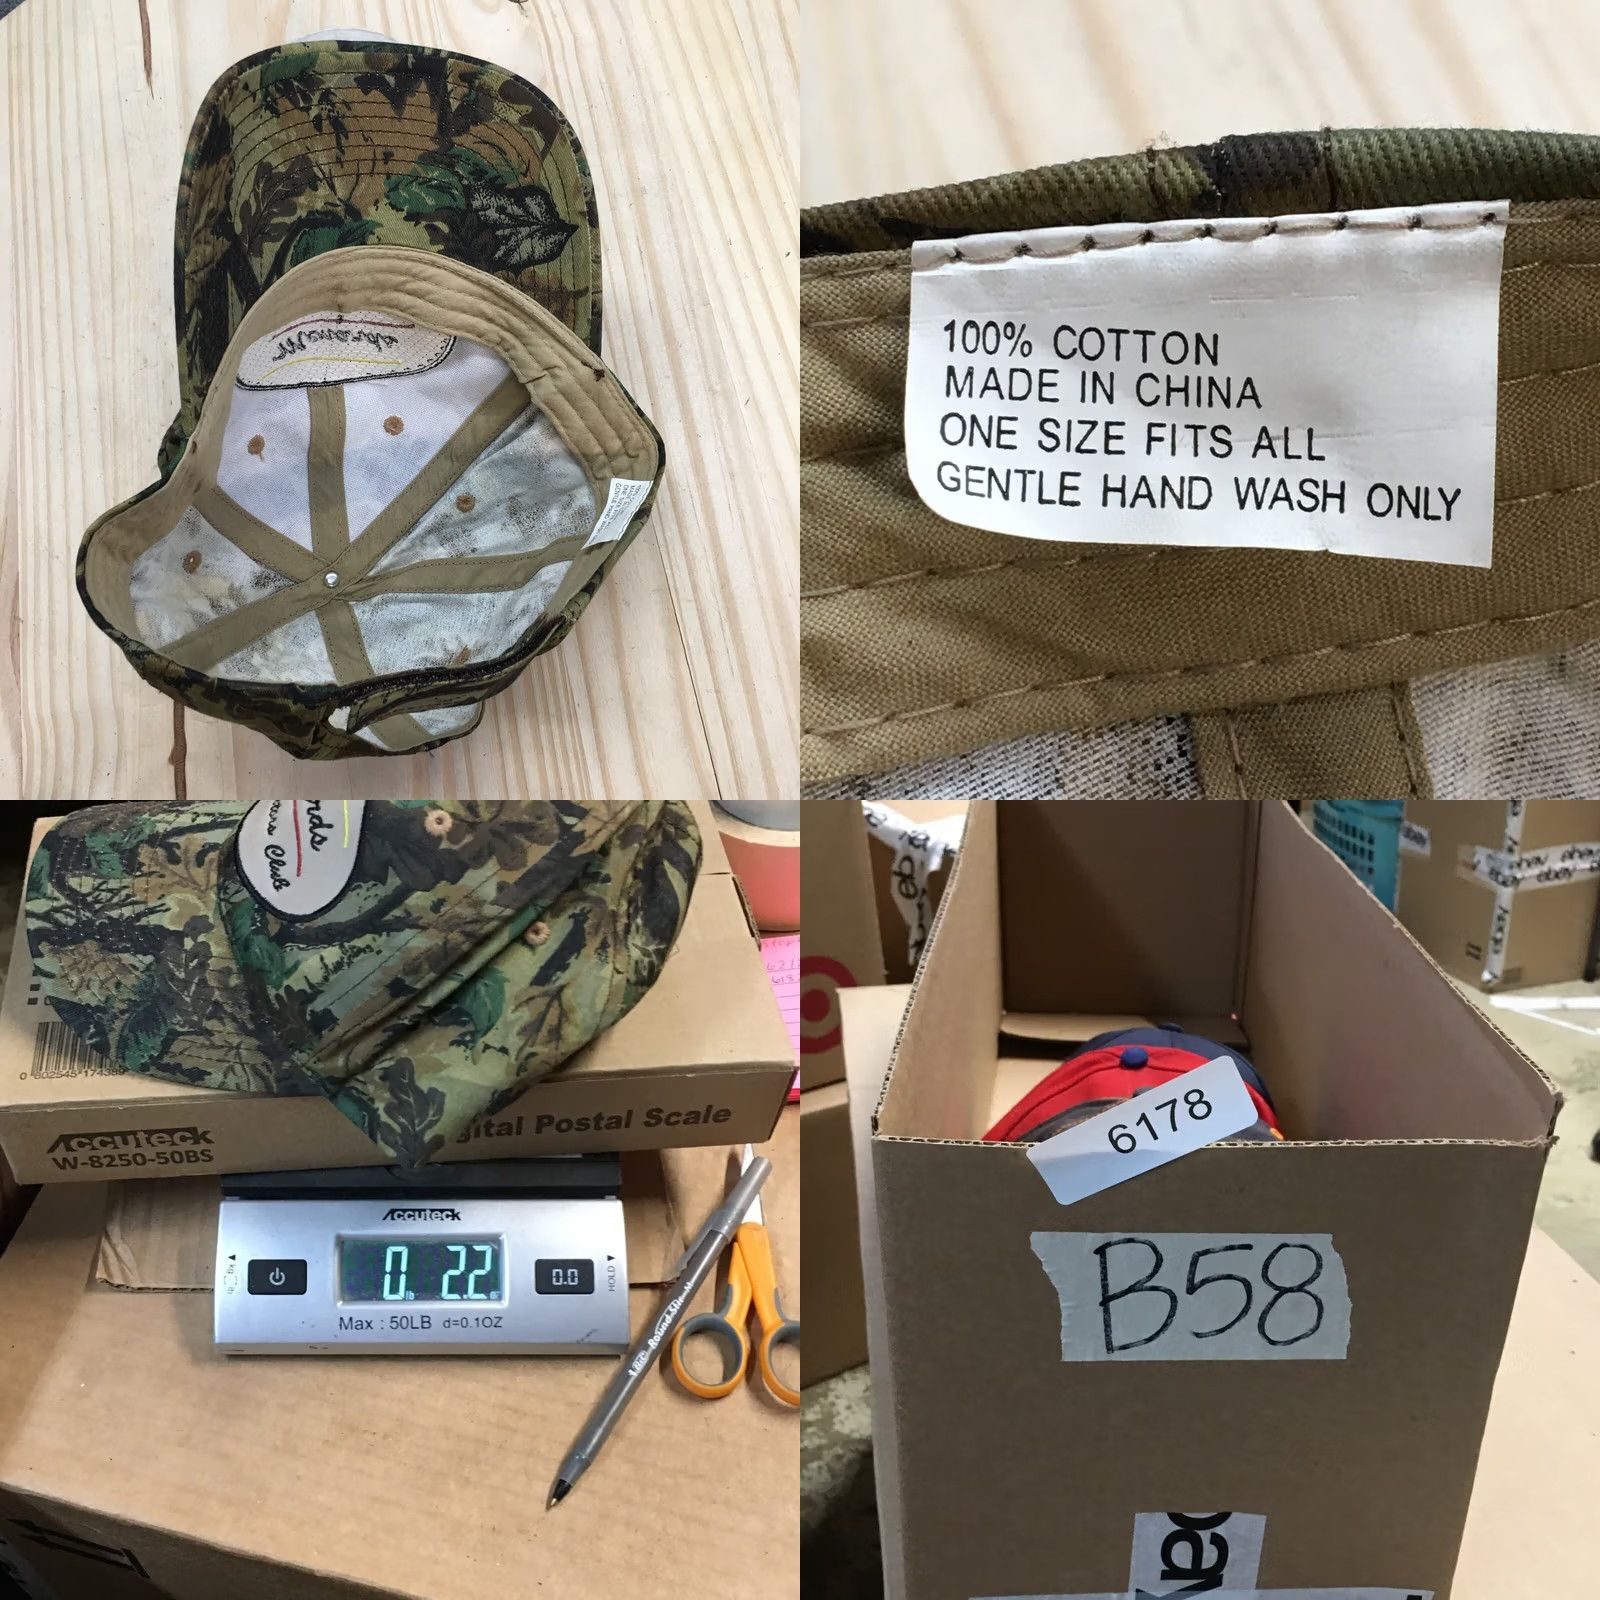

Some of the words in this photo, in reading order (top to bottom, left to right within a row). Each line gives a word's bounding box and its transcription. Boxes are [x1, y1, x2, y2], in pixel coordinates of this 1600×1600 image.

[943, 320, 1033, 358] 100%
[1053, 324, 1220, 367] COTTON
[945, 366, 1059, 403] MADE
[1080, 370, 1115, 405] IN
[1135, 372, 1262, 409] CHINA
[939, 412, 1018, 450] ONE
[1037, 418, 1125, 456] SIZE
[1146, 422, 1233, 459] FITS
[1252, 426, 1326, 462] ALL
[936, 461, 1082, 507] GENTLE
[1101, 474, 1213, 511] HAND
[1234, 477, 1345, 514] WASH
[1367, 483, 1462, 522] ONLY
[264, 844, 291, 892] Club
[535, 1110, 634, 1134] Postal
[643, 1104, 732, 1128] Scale
[1107, 1089, 1213, 1154] 6178
[52, 1149, 215, 1171] W-8250-50BS
[383, 1246, 408, 1300] 0
[552, 1269, 578, 1286] 0.0
[607, 1265, 616, 1292] HOLD
[1093, 1237, 1324, 1354] B58
[339, 1317, 374, 1330] Max
[389, 1315, 432, 1330] 50LB
[647, 1312, 674, 1350] Round
